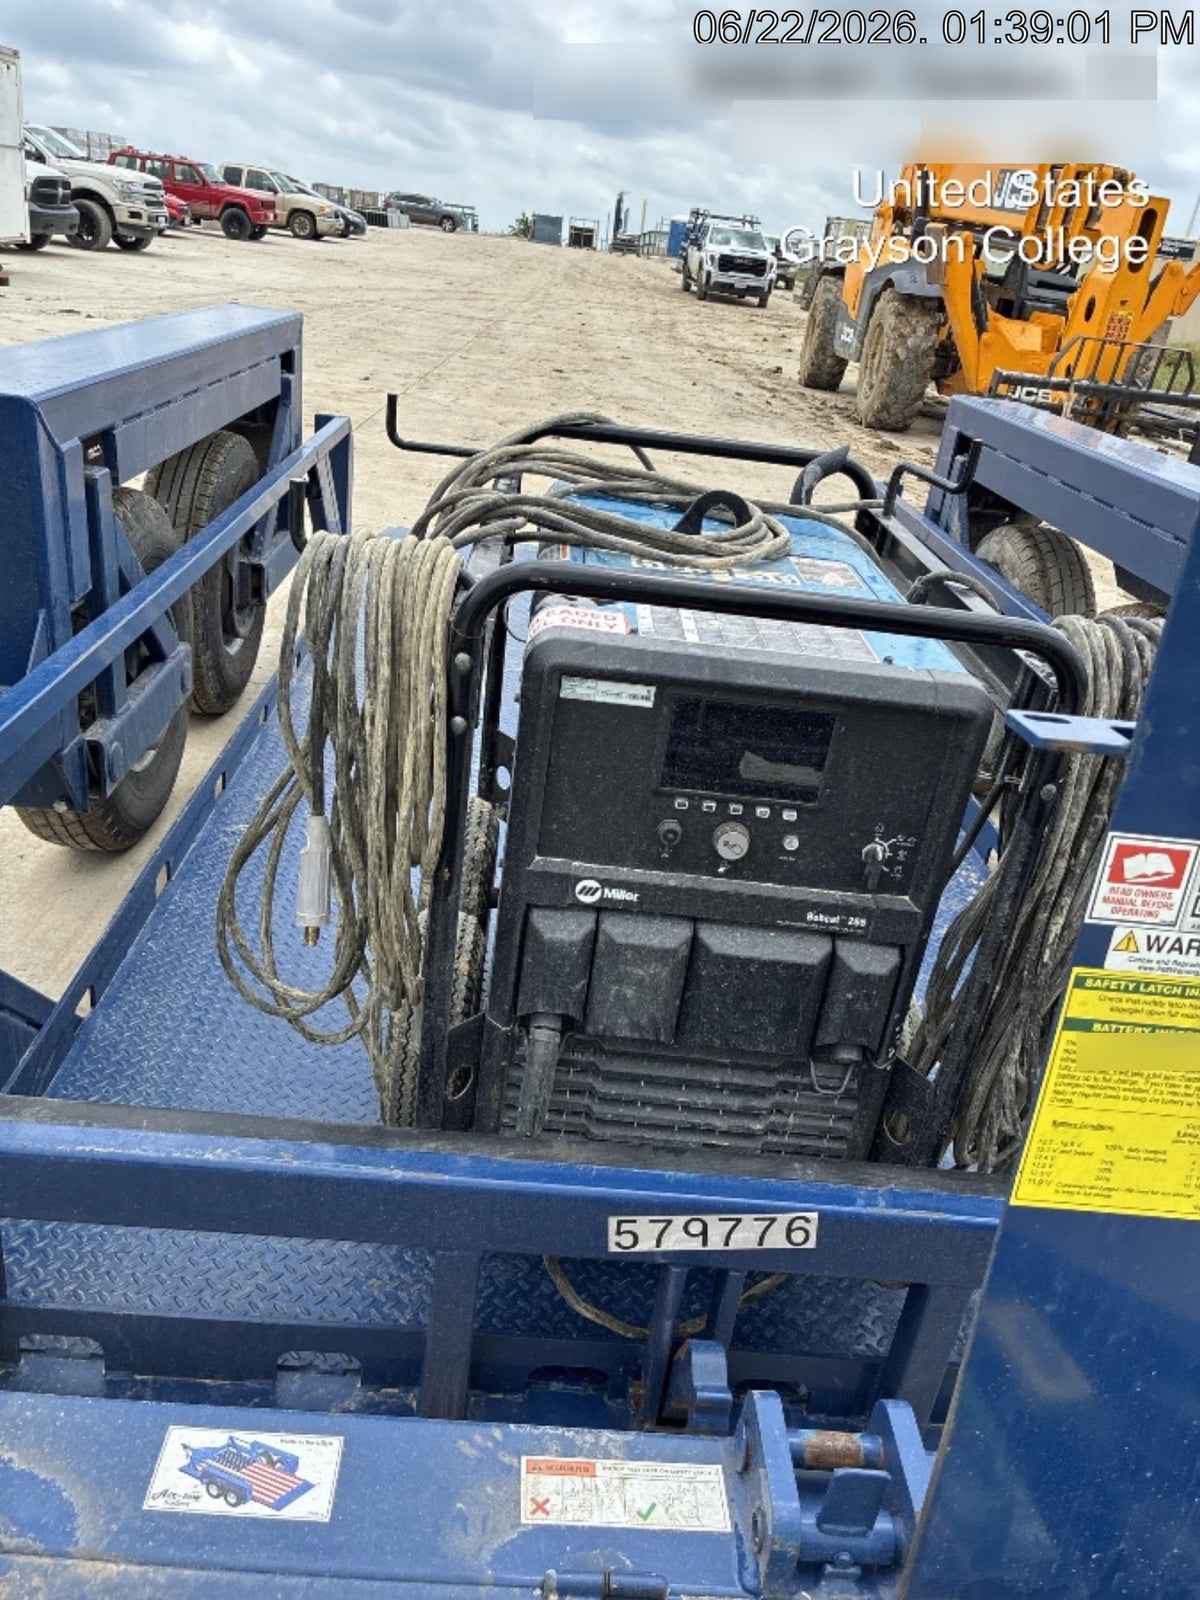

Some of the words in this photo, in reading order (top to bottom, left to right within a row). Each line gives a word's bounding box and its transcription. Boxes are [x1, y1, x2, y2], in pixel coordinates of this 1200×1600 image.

[560, 616, 618, 630] ONLY
[603, 887, 641, 902] Miller
[1109, 886, 1133, 897] READ
[1134, 888, 1173, 900] OWNERS
[1102, 895, 1138, 907] MANUAL
[1140, 899, 1175, 911] BEFORE
[1110, 906, 1160, 919] OPERATING
[1128, 955, 1154, 964] Cancer
[1155, 958, 1170, 966] and
[1084, 978, 1137, 991] SAFETY
[1139, 982, 1182, 995] LATCH
[1098, 994, 1123, 1003] Check
[1125, 996, 1141, 1005] that
[1142, 998, 1167, 1008] safety
[1092, 1022, 1153, 1034] BATTERY
[613, 1215, 812, 1250] 579776
